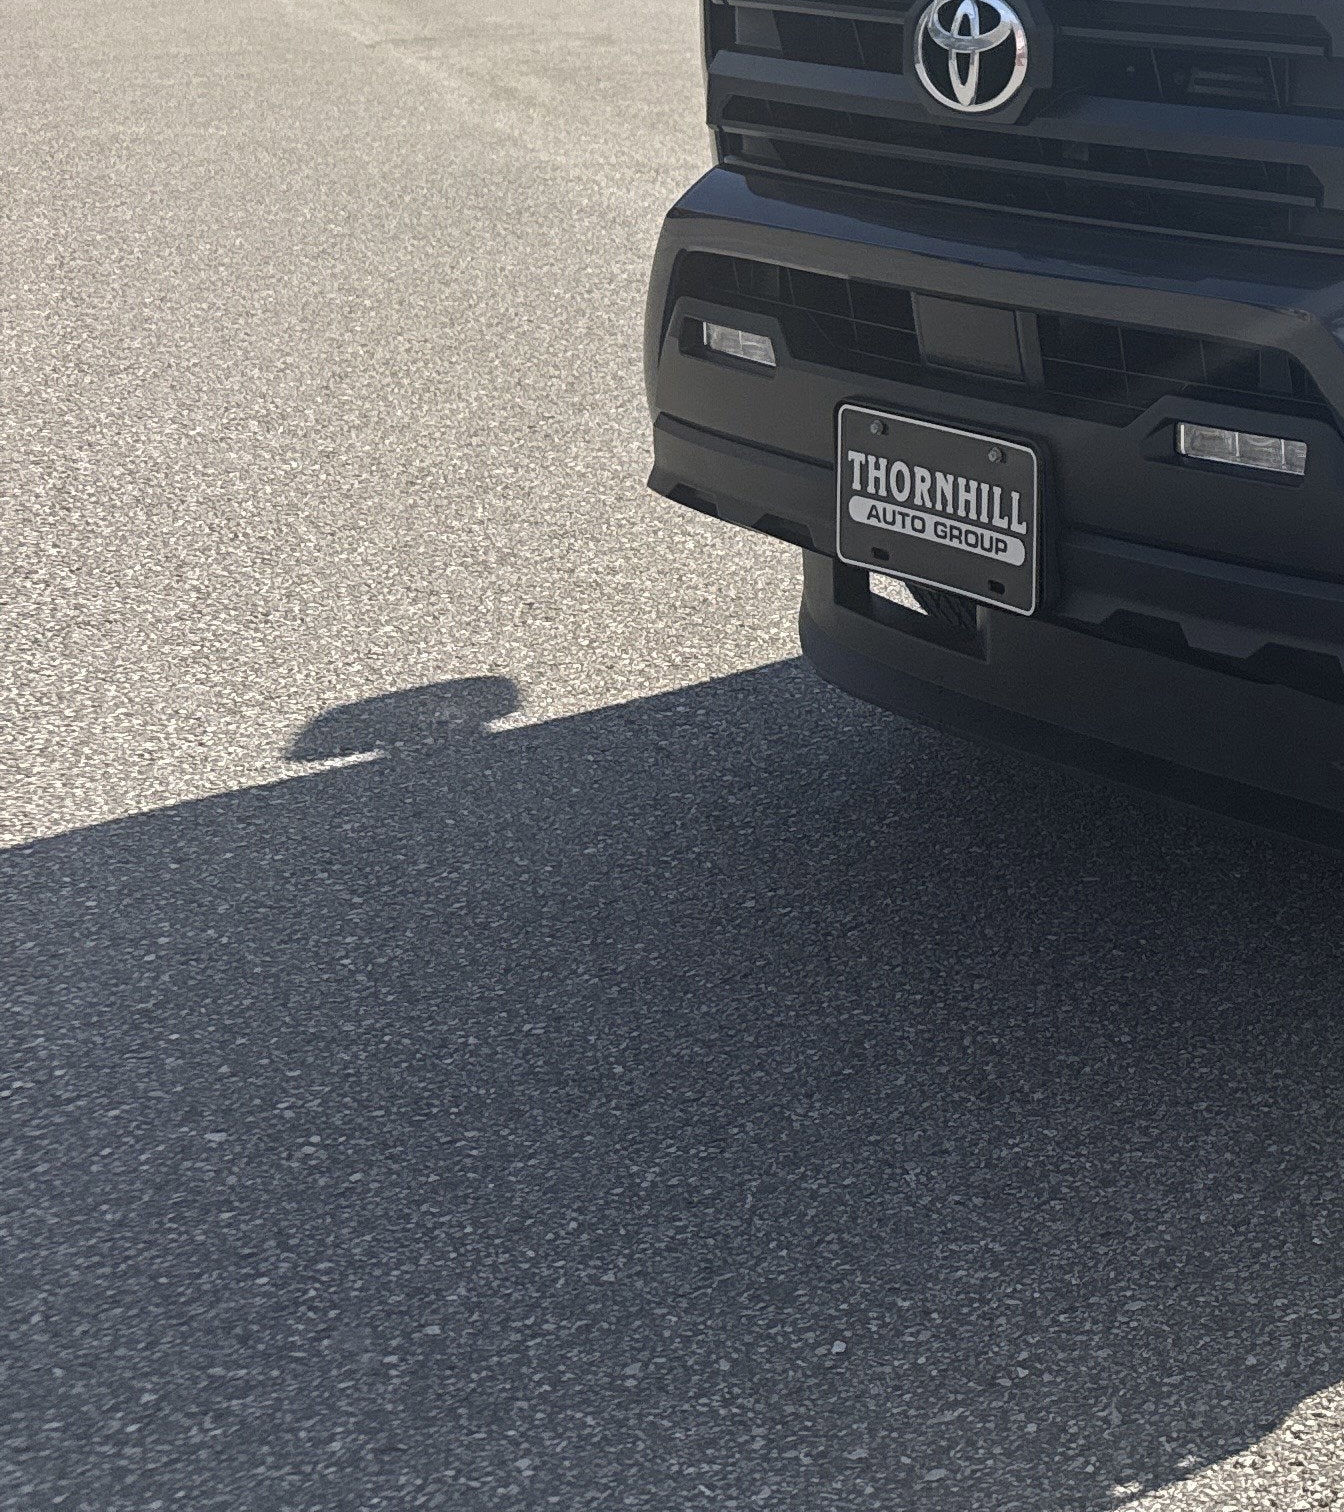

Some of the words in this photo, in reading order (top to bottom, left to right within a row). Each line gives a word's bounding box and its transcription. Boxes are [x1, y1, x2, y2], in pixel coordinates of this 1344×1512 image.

[847, 450, 1027, 535] THORNHILL
[867, 504, 926, 534] AUTO
[933, 520, 1008, 556] GROUP
